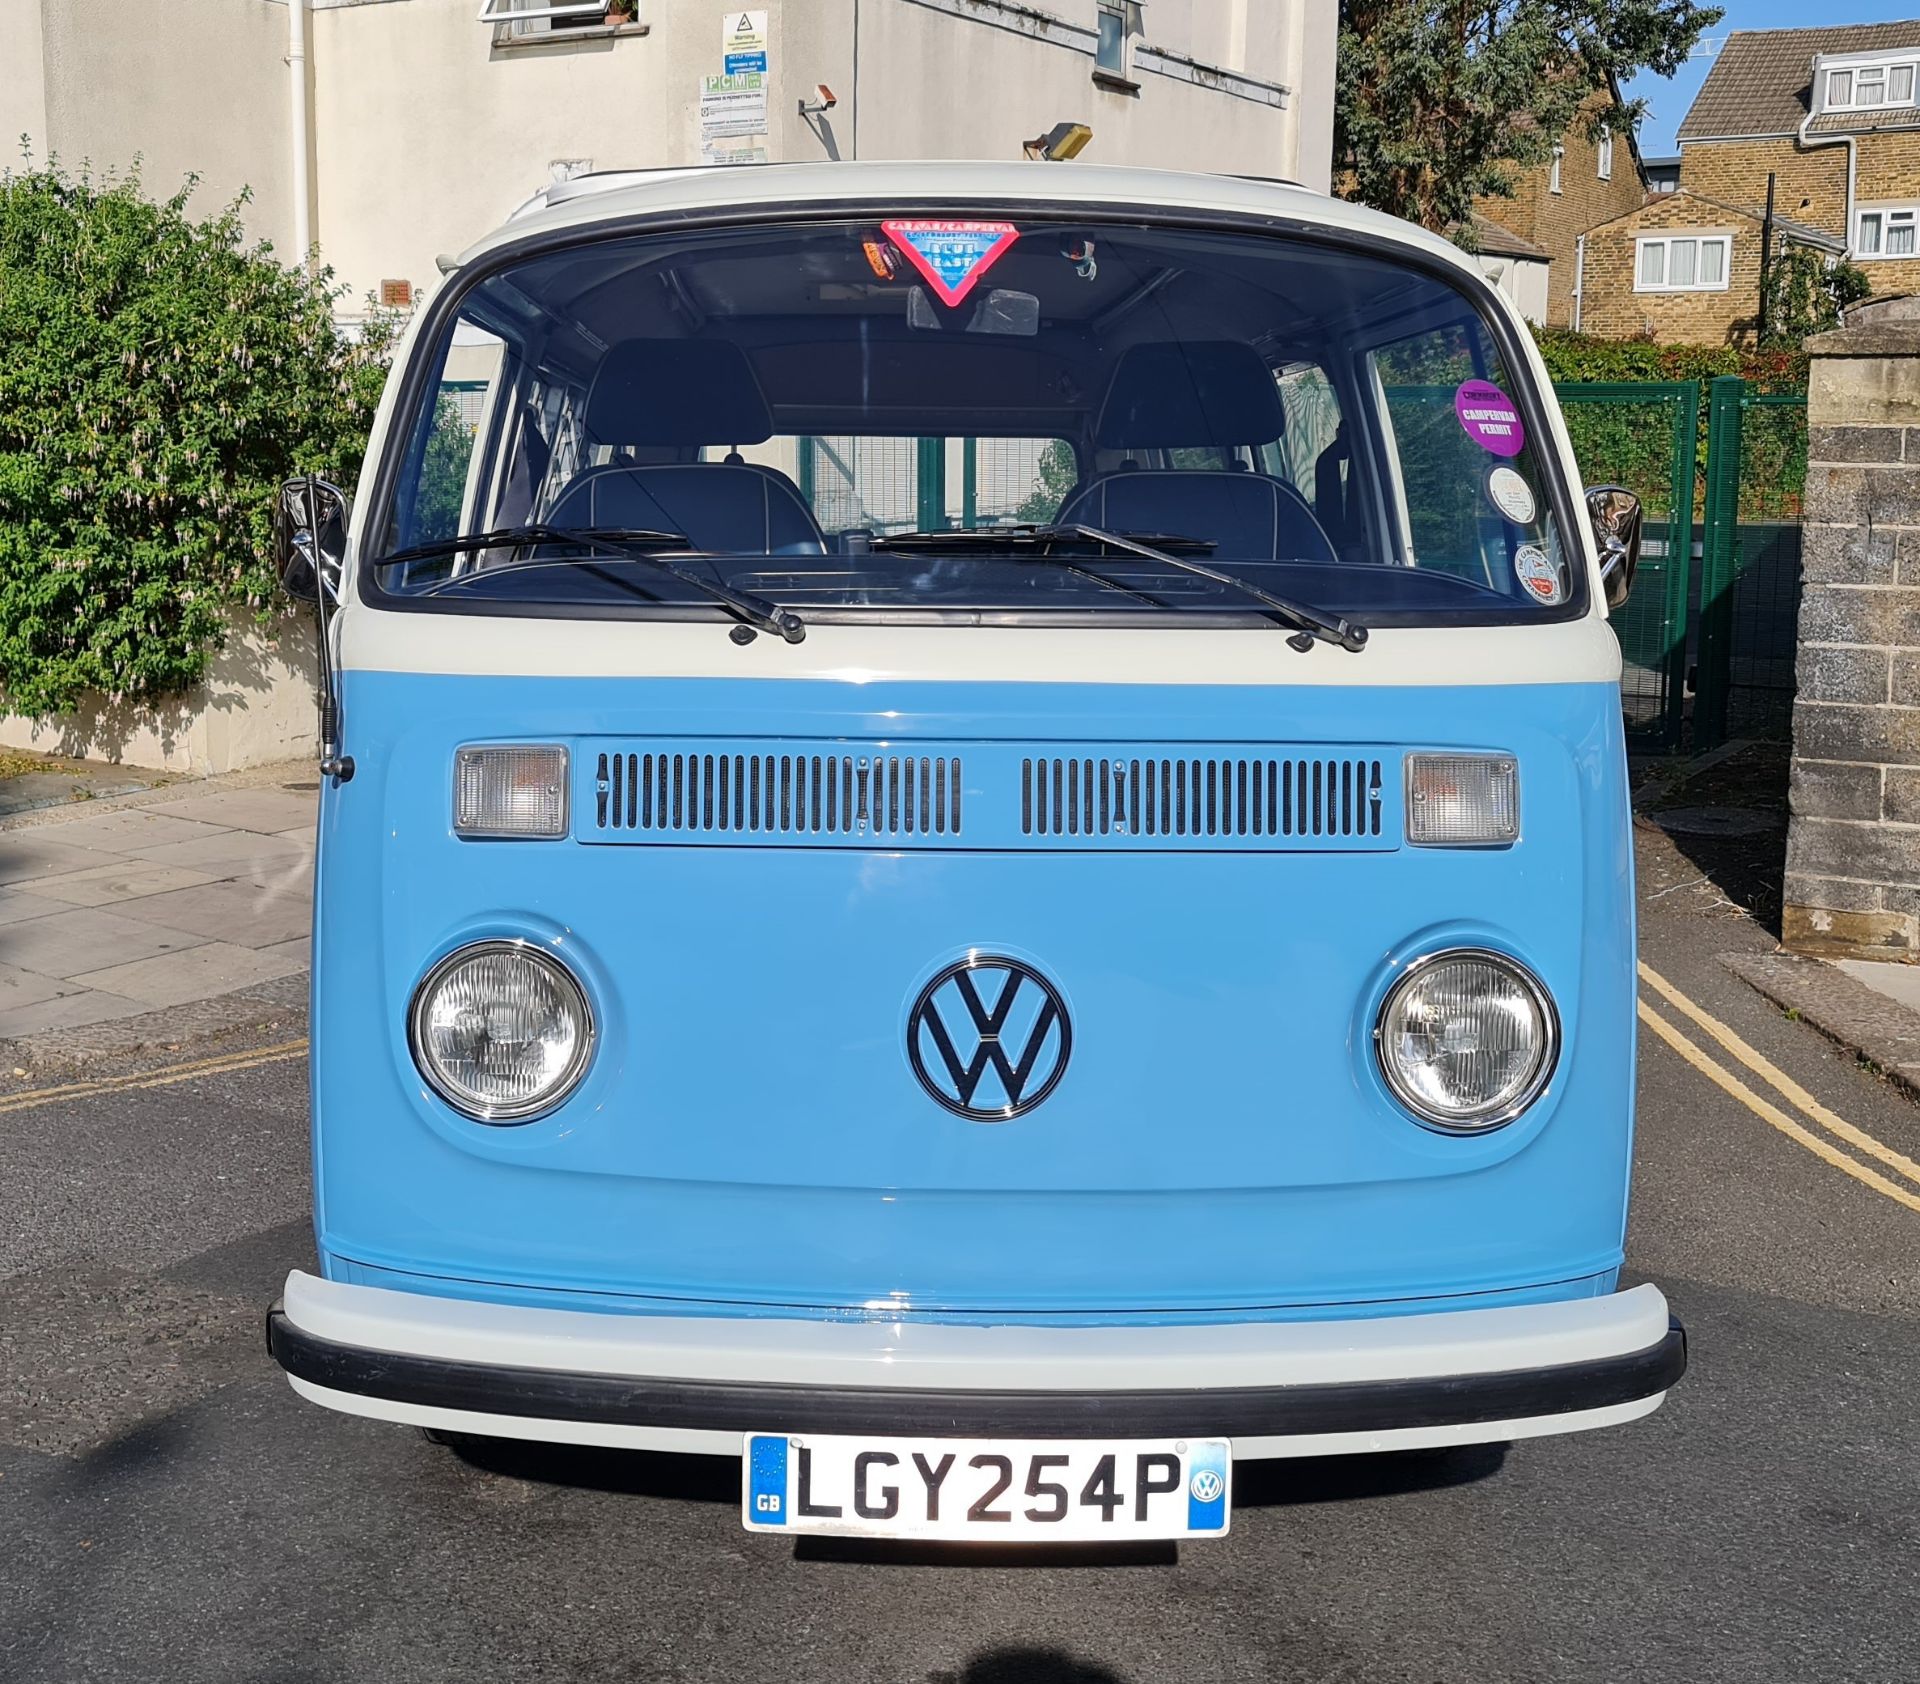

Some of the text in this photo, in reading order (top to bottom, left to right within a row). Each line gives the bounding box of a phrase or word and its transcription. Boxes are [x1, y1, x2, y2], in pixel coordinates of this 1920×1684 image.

[708, 74, 747, 89] PCM
[930, 242, 974, 254] BLUE
[932, 256, 973, 268] EAST
[1462, 409, 1517, 422] CAMPERVAN
[1478, 423, 1512, 436] PERMIT
[757, 1494, 781, 1512] GB
